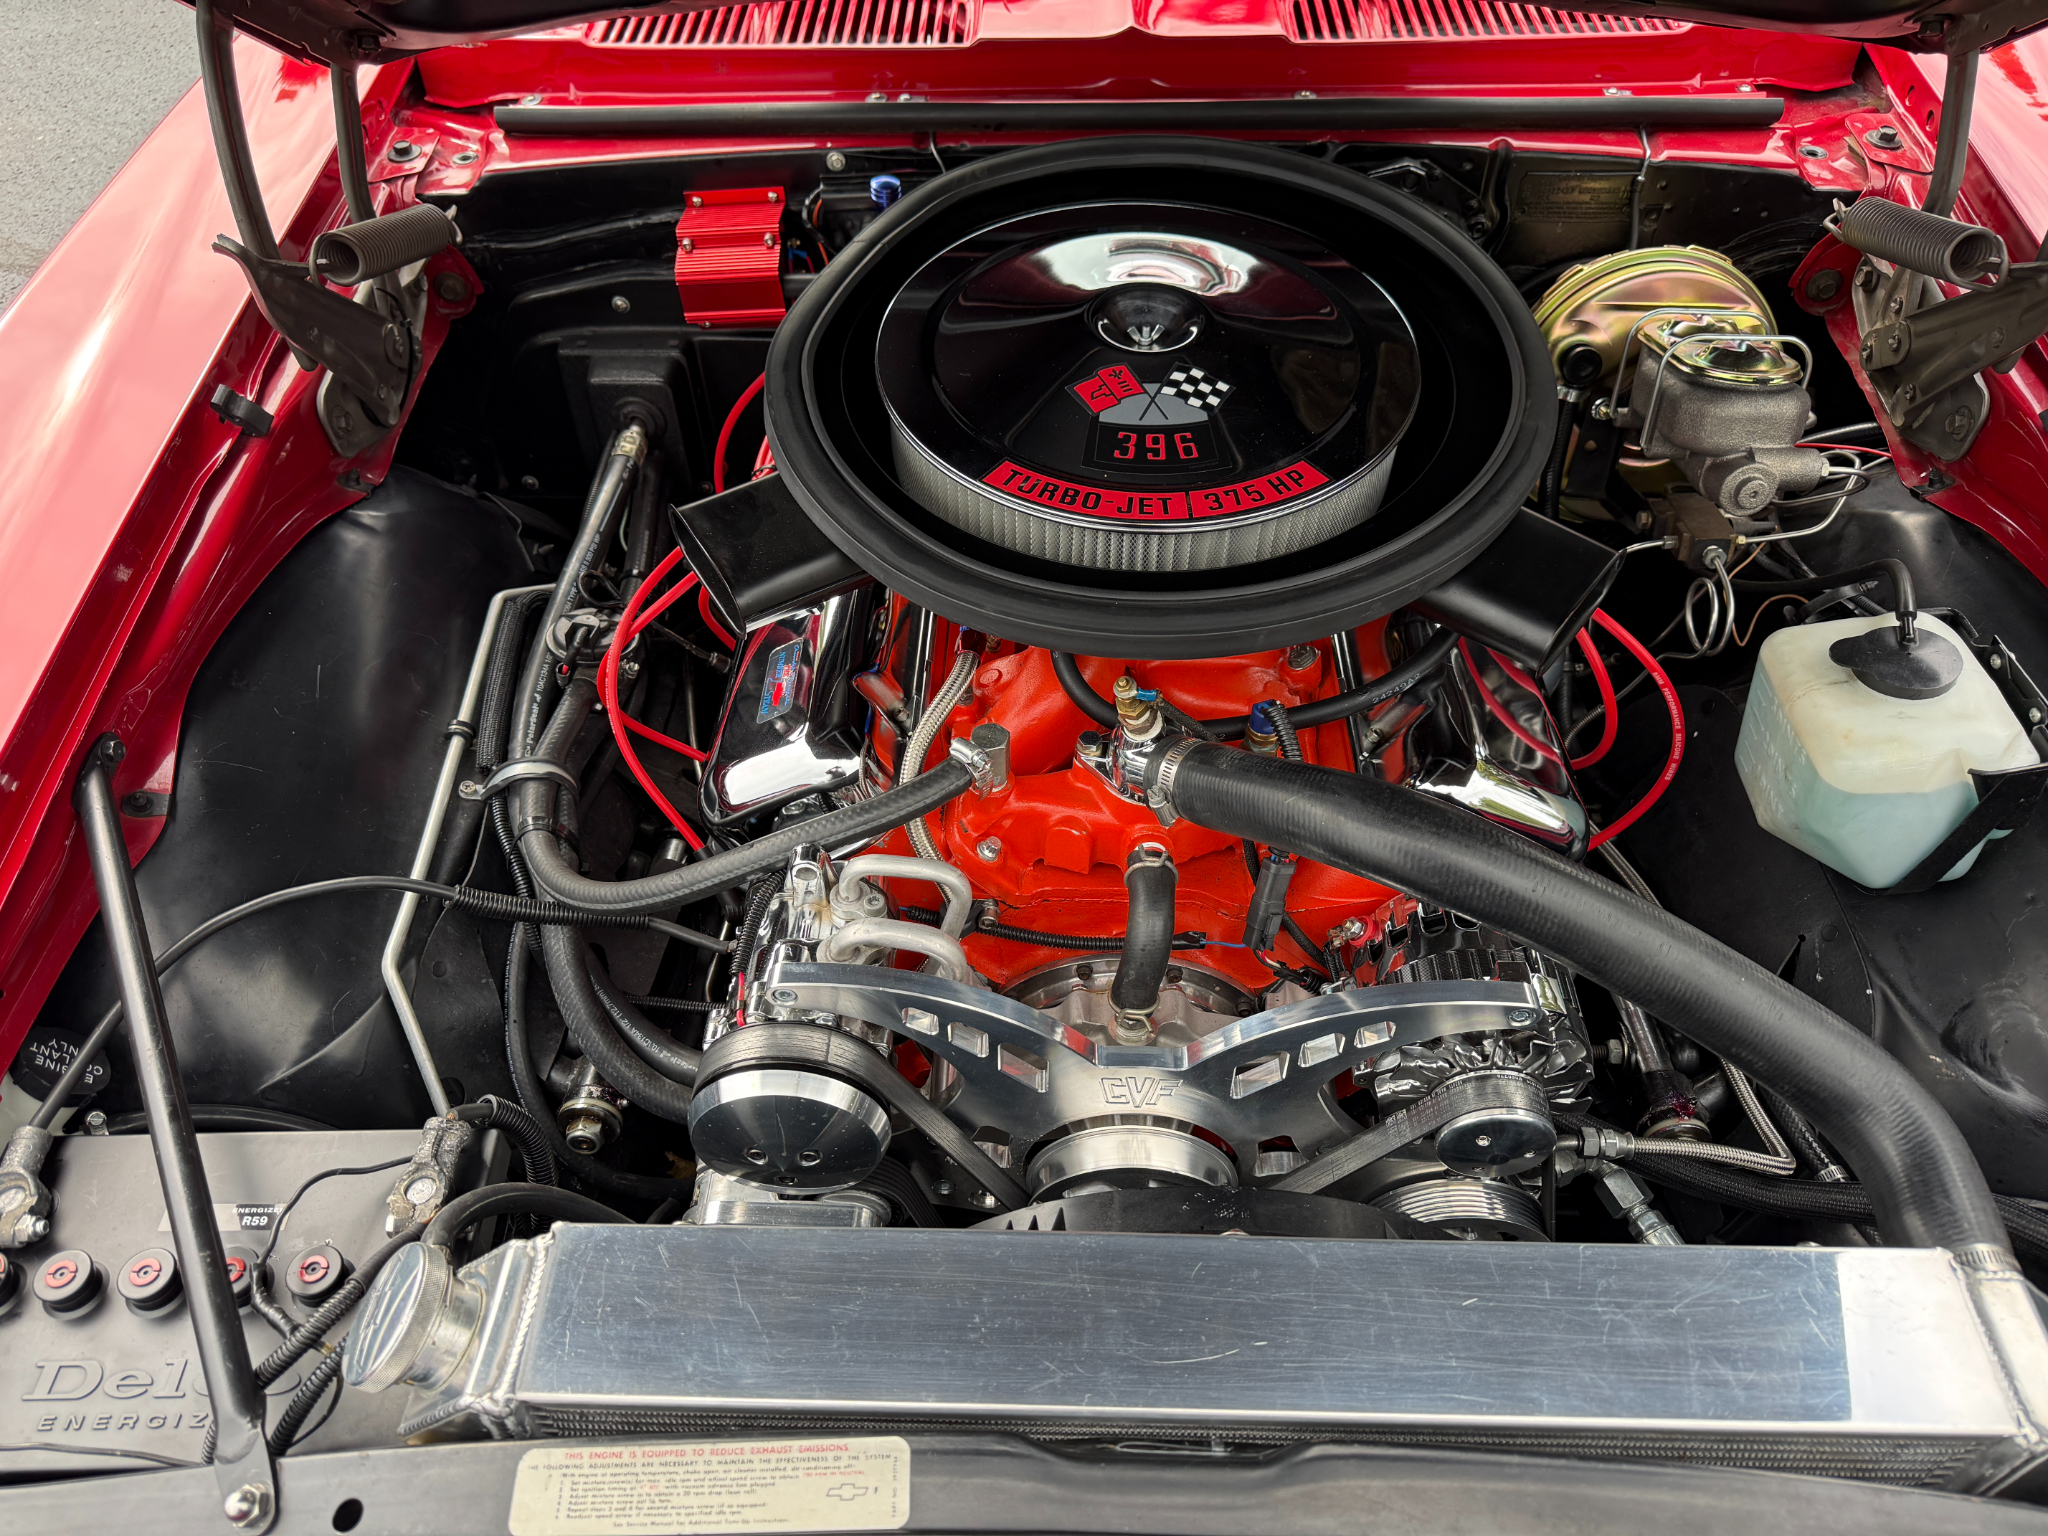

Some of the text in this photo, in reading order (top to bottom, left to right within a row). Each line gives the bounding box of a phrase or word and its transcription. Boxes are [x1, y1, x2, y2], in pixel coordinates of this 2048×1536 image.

[1113, 431, 1199, 461] 396
[1002, 469, 1173, 516] TURBO-JET
[1204, 483, 1265, 511] 375
[1270, 469, 1307, 498] HP
[1372, 673, 1420, 704] 24249A2
[1662, 687, 1681, 729] PERFORMANCE
[1673, 733, 1682, 760] SILICONE
[1664, 763, 1677, 781] WIRES
[48, 1038, 79, 1056] NLY
[35, 1054, 94, 1084] EGINE
[1099, 1077, 1183, 1108] CVF
[241, 1215, 268, 1226] R59
[37, 1411, 212, 1432] ENERGIZ
[565, 1452, 583, 1460] THIS
[589, 1451, 623, 1459] ENGINE
[642, 1449, 686, 1458] EQUIPPED
[710, 1447, 744, 1456] REDUCE
[750, 1446, 792, 1454] EXHAUST
[798, 1444, 849, 1453] EMISSIONS
[776, 1456, 828, 1464] EFFECTIVENESS
